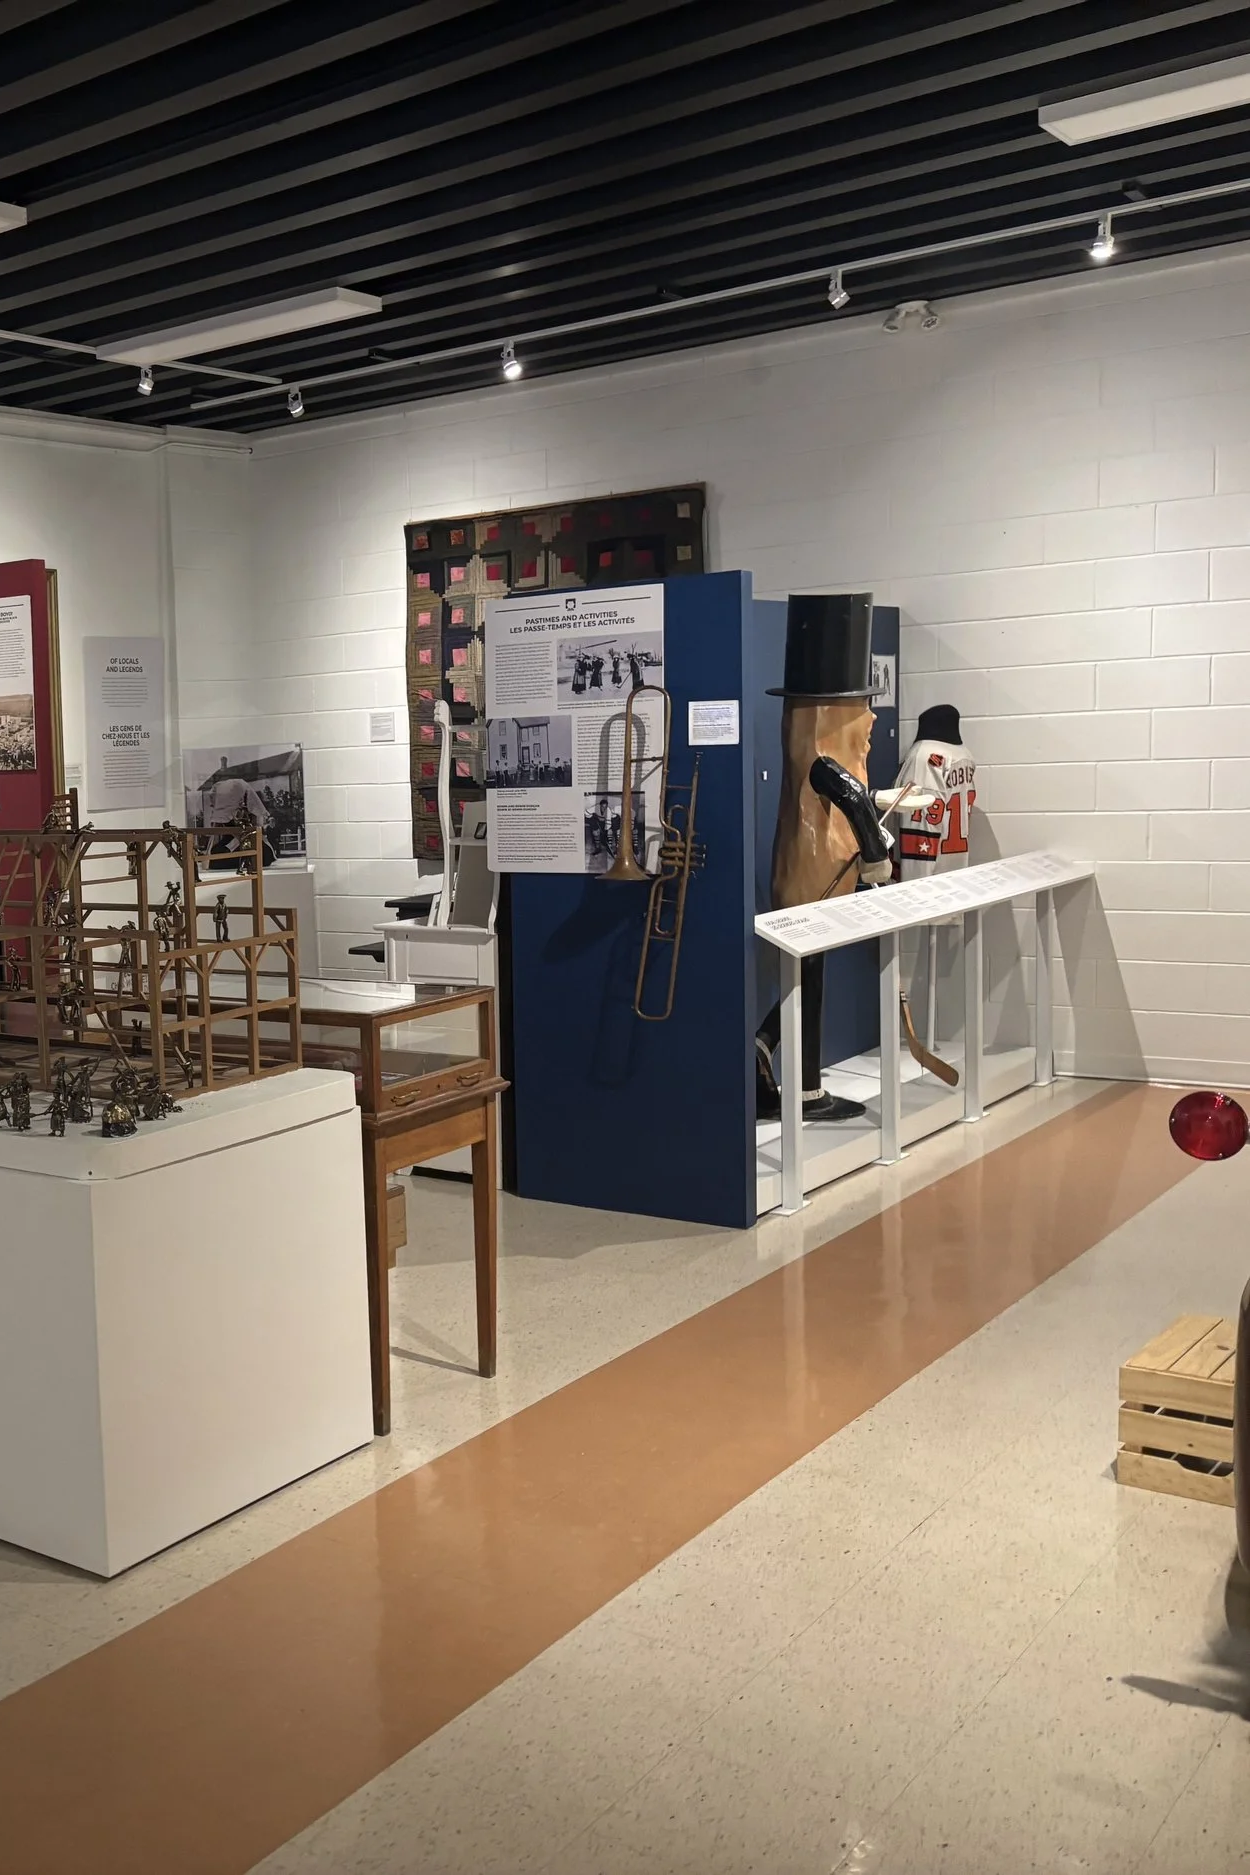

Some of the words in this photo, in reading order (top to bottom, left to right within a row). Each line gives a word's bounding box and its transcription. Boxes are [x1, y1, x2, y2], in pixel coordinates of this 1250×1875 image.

[525, 616, 560, 625] PASTIMES
[561, 614, 578, 622] AND
[578, 610, 618, 620] ACTIVITIES
[523, 622, 572, 632] PASSE-TEMPS
[583, 620, 597, 628] LES
[597, 616, 635, 626] ACTIVITÉS
[119, 657, 139, 665] LOCALS
[101, 732, 133, 740] CHEZ-NOUS
